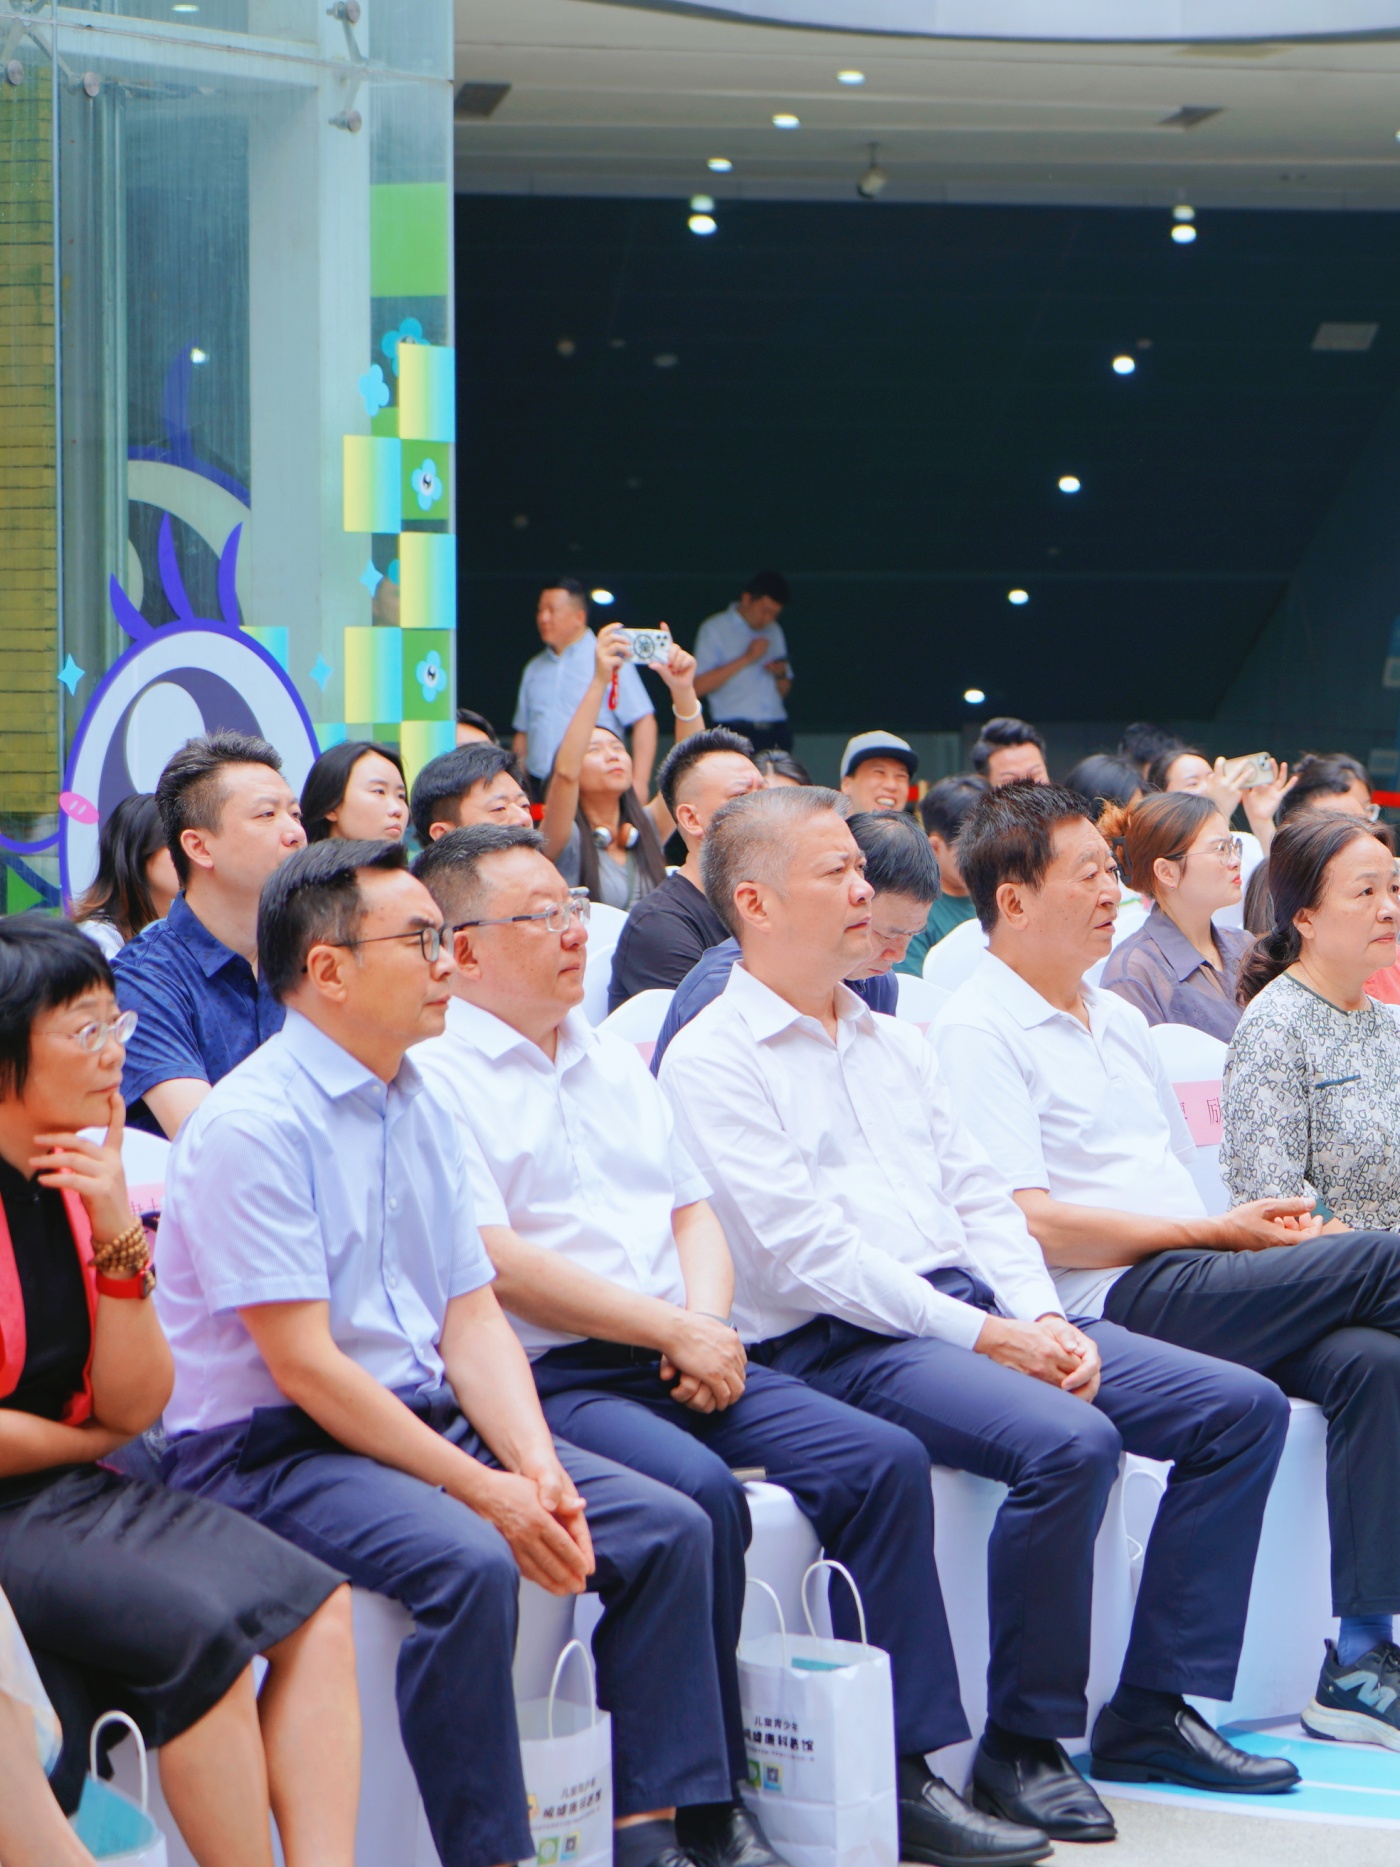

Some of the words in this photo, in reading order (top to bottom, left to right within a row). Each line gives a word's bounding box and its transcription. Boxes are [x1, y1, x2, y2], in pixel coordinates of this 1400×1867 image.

[754, 1715, 798, 1732] 儿童青少年
